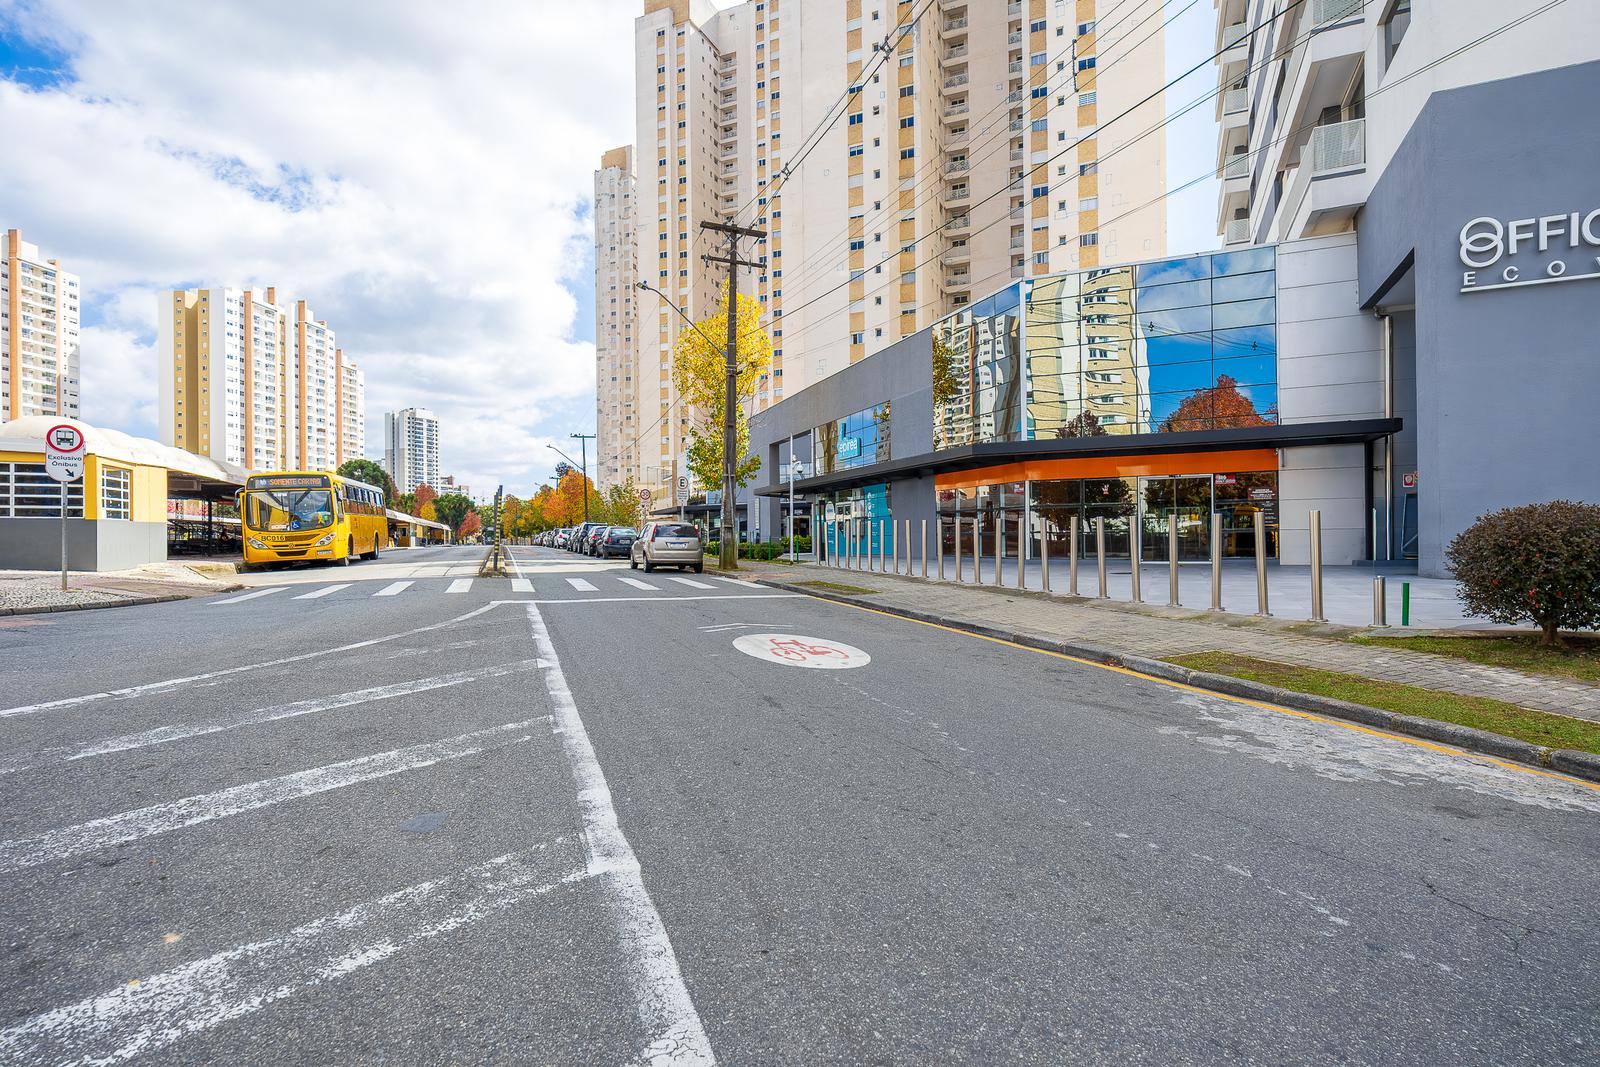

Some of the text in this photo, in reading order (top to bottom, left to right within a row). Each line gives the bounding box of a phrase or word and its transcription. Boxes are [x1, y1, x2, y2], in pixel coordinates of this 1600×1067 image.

[47, 454, 82, 462] Exclusivo
[51, 460, 78, 468] Ônibus
[679, 478, 686, 488] E
